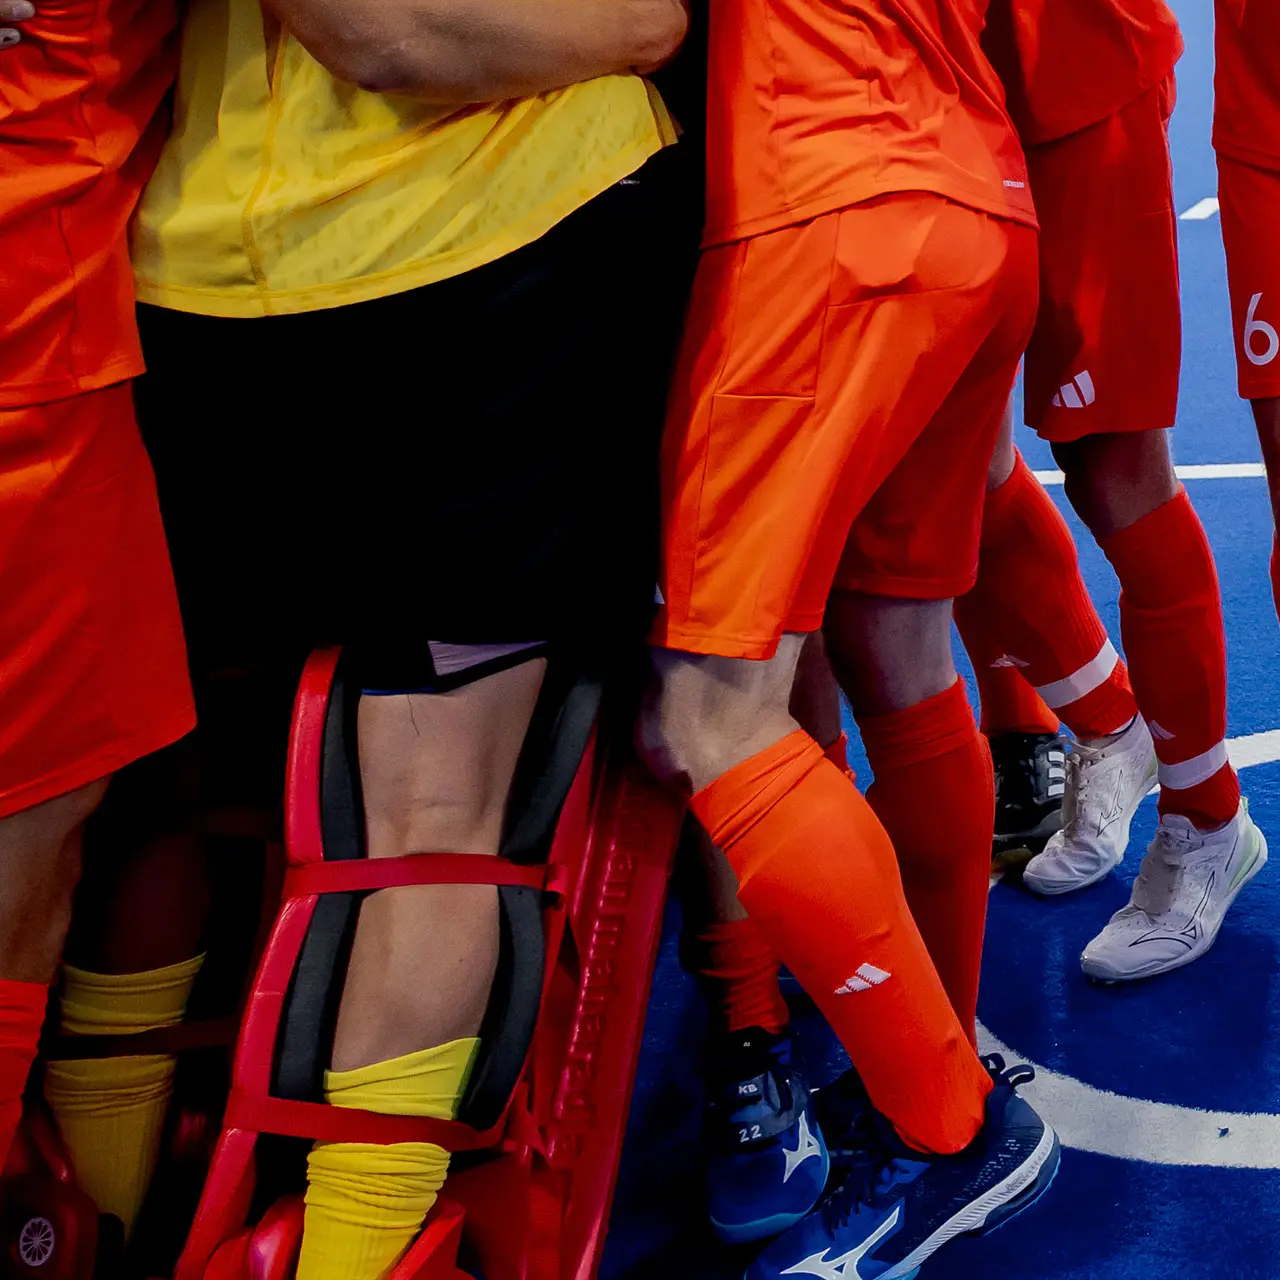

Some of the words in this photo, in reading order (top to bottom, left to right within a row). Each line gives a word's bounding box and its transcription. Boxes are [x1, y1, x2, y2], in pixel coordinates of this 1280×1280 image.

[1242, 291, 1280, 367] 6
[738, 1083, 758, 1095] KB
[738, 1124, 762, 1143] 22
